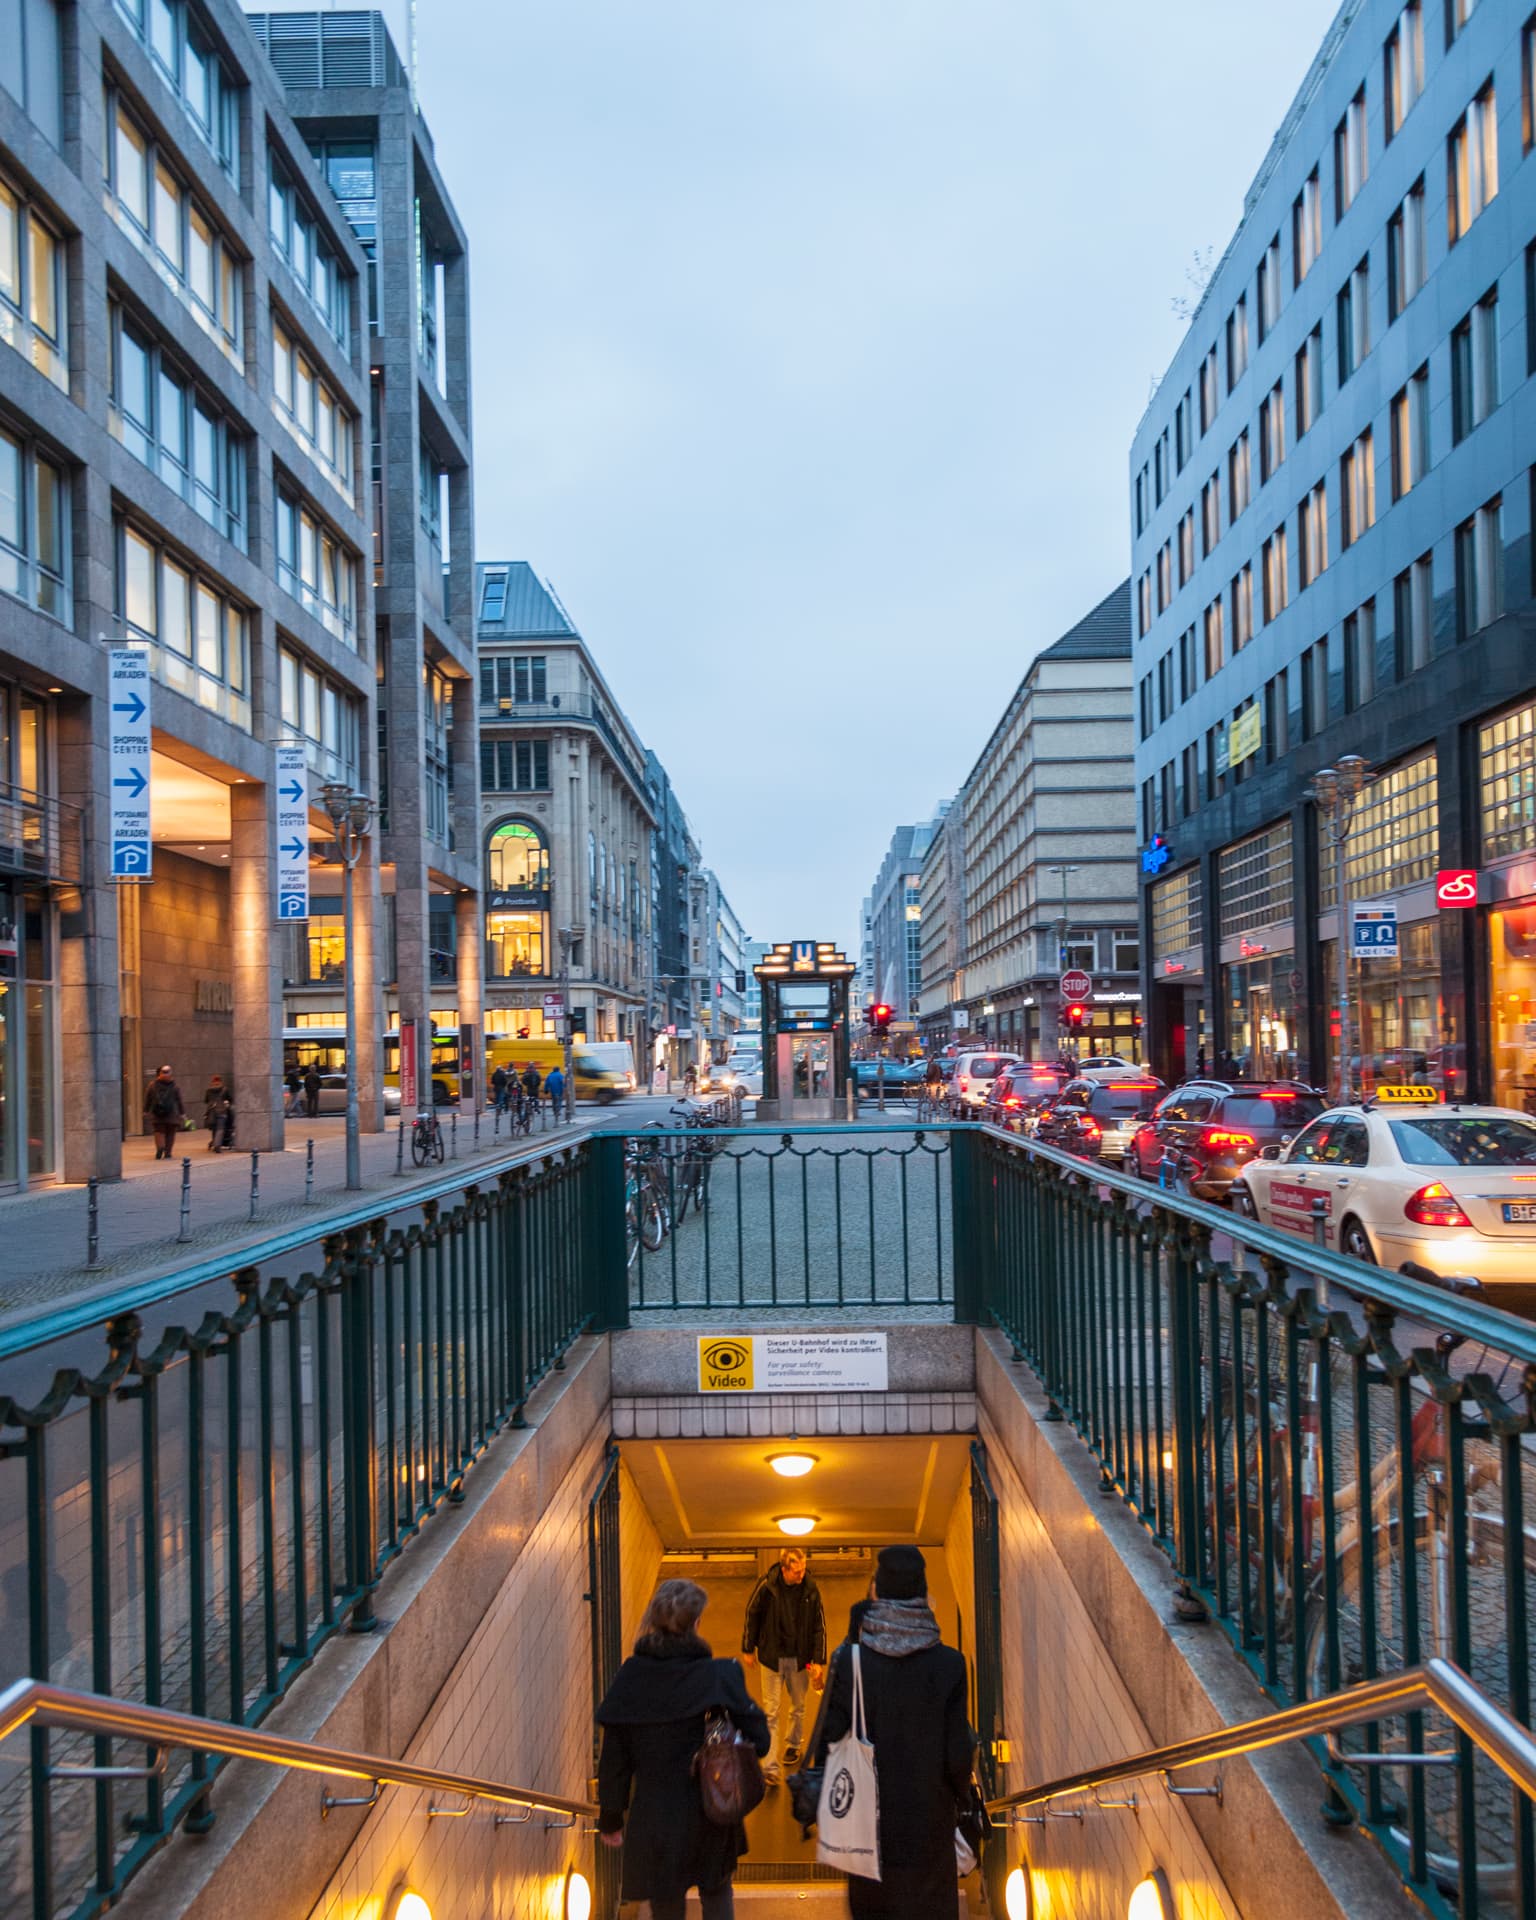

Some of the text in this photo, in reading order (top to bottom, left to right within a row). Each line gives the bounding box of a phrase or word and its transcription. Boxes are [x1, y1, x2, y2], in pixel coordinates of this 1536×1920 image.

[112, 736, 148, 744] SHOPPING
[113, 746, 148, 754] CENTER
[124, 851, 140, 872] P
[796, 943, 812, 961] U
[1063, 979, 1088, 991] STOP
[1388, 1088, 1433, 1097] TAXI
[791, 1338, 830, 1346] U-Bahnhof
[767, 1346, 804, 1354] Sicherheit
[780, 1362, 798, 1370] your
[708, 1374, 746, 1387] Video
